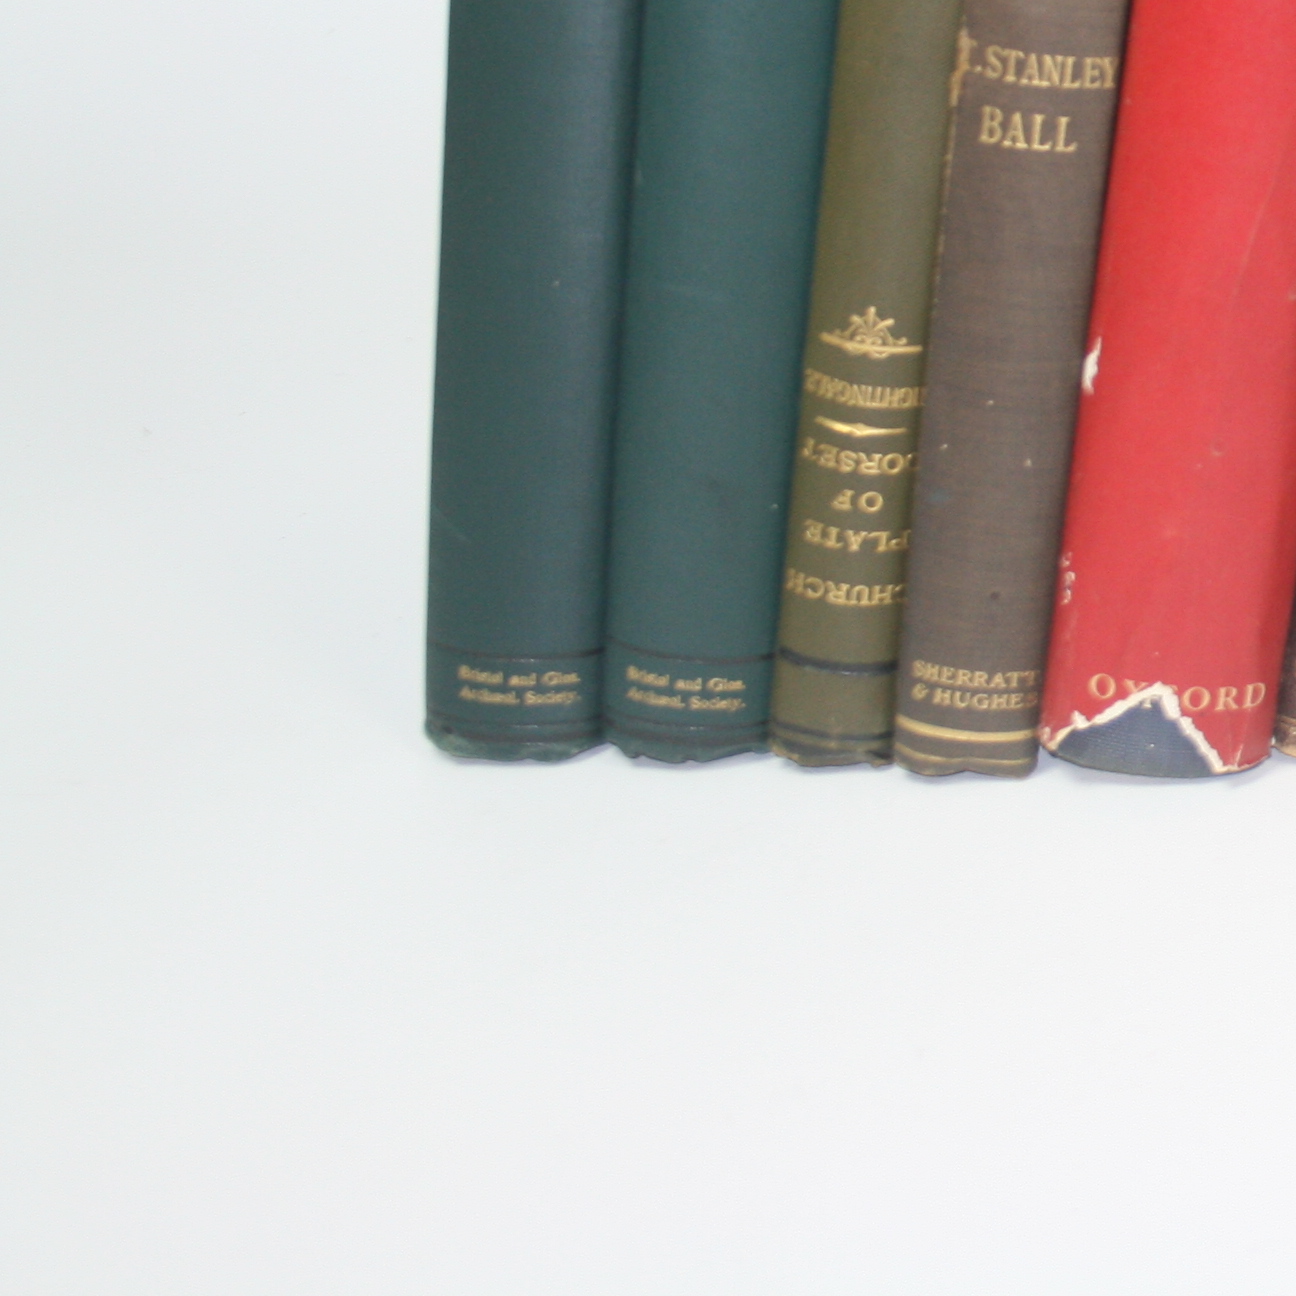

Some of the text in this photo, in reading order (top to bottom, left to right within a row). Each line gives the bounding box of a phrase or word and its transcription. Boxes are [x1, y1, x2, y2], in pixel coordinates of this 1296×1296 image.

[979, 105, 1078, 153] BALL
[803, 368, 925, 410] IGHTINGALE
[832, 489, 883, 514] OF
[803, 518, 912, 553] PLATE
[912, 659, 1040, 689] SHERRATT
[911, 682, 1038, 710] & HUGHES
[1086, 672, 1267, 713] OXORD
